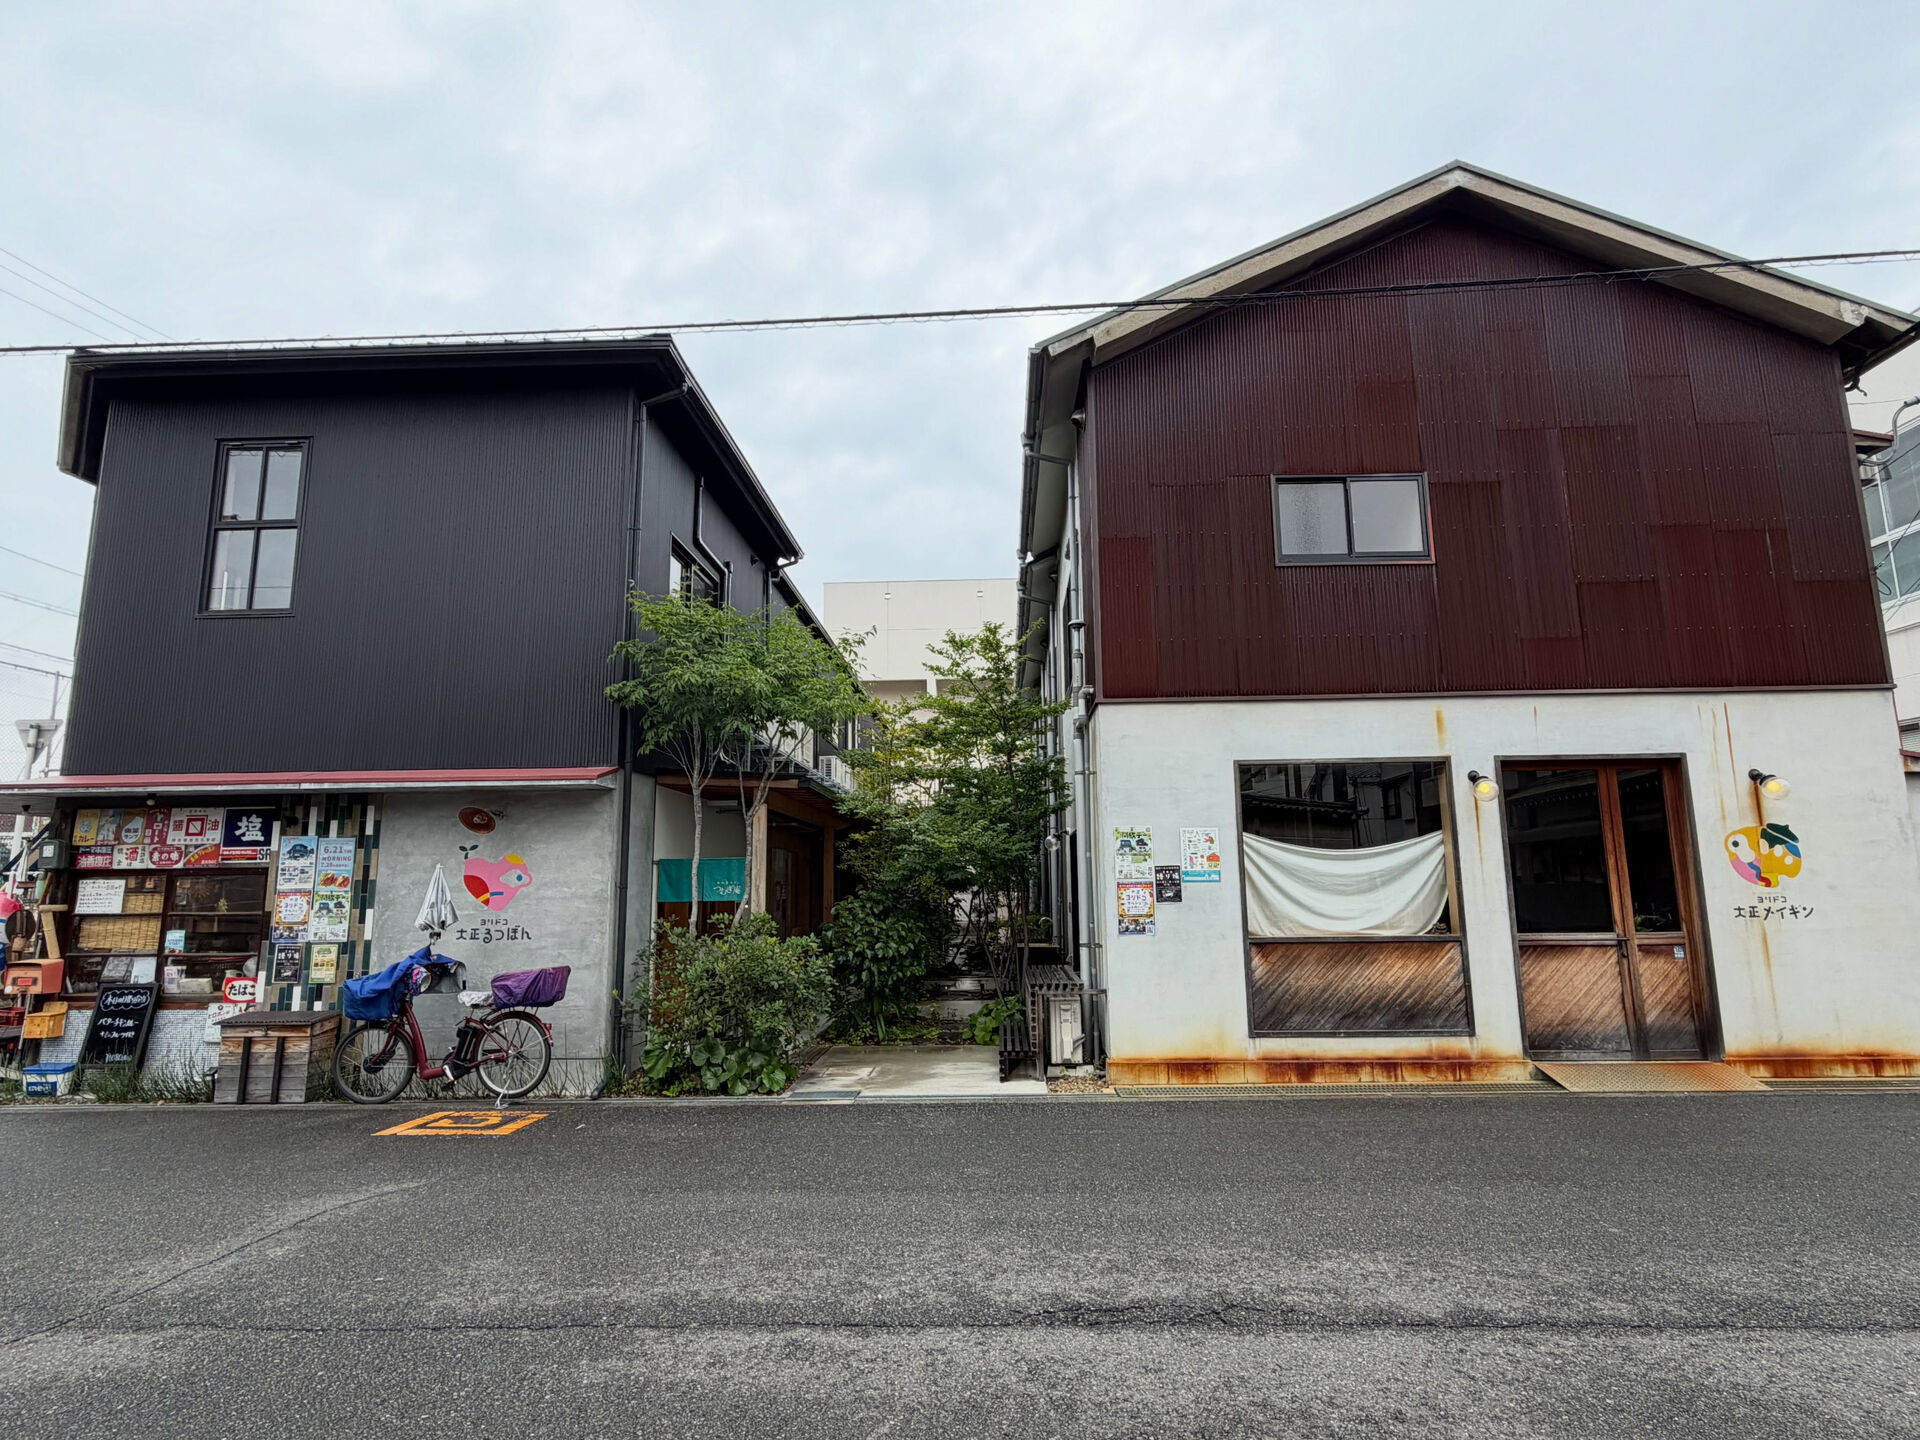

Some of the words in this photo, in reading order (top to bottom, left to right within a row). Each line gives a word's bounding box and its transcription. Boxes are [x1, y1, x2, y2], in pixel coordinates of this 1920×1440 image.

[234, 814, 265, 842] 塩
[324, 846, 344, 854] 6.21
[480, 918, 508, 926] ヨリドコ
[456, 925, 532, 944] 大正るつぼん
[228, 983, 256, 996] たばこ
